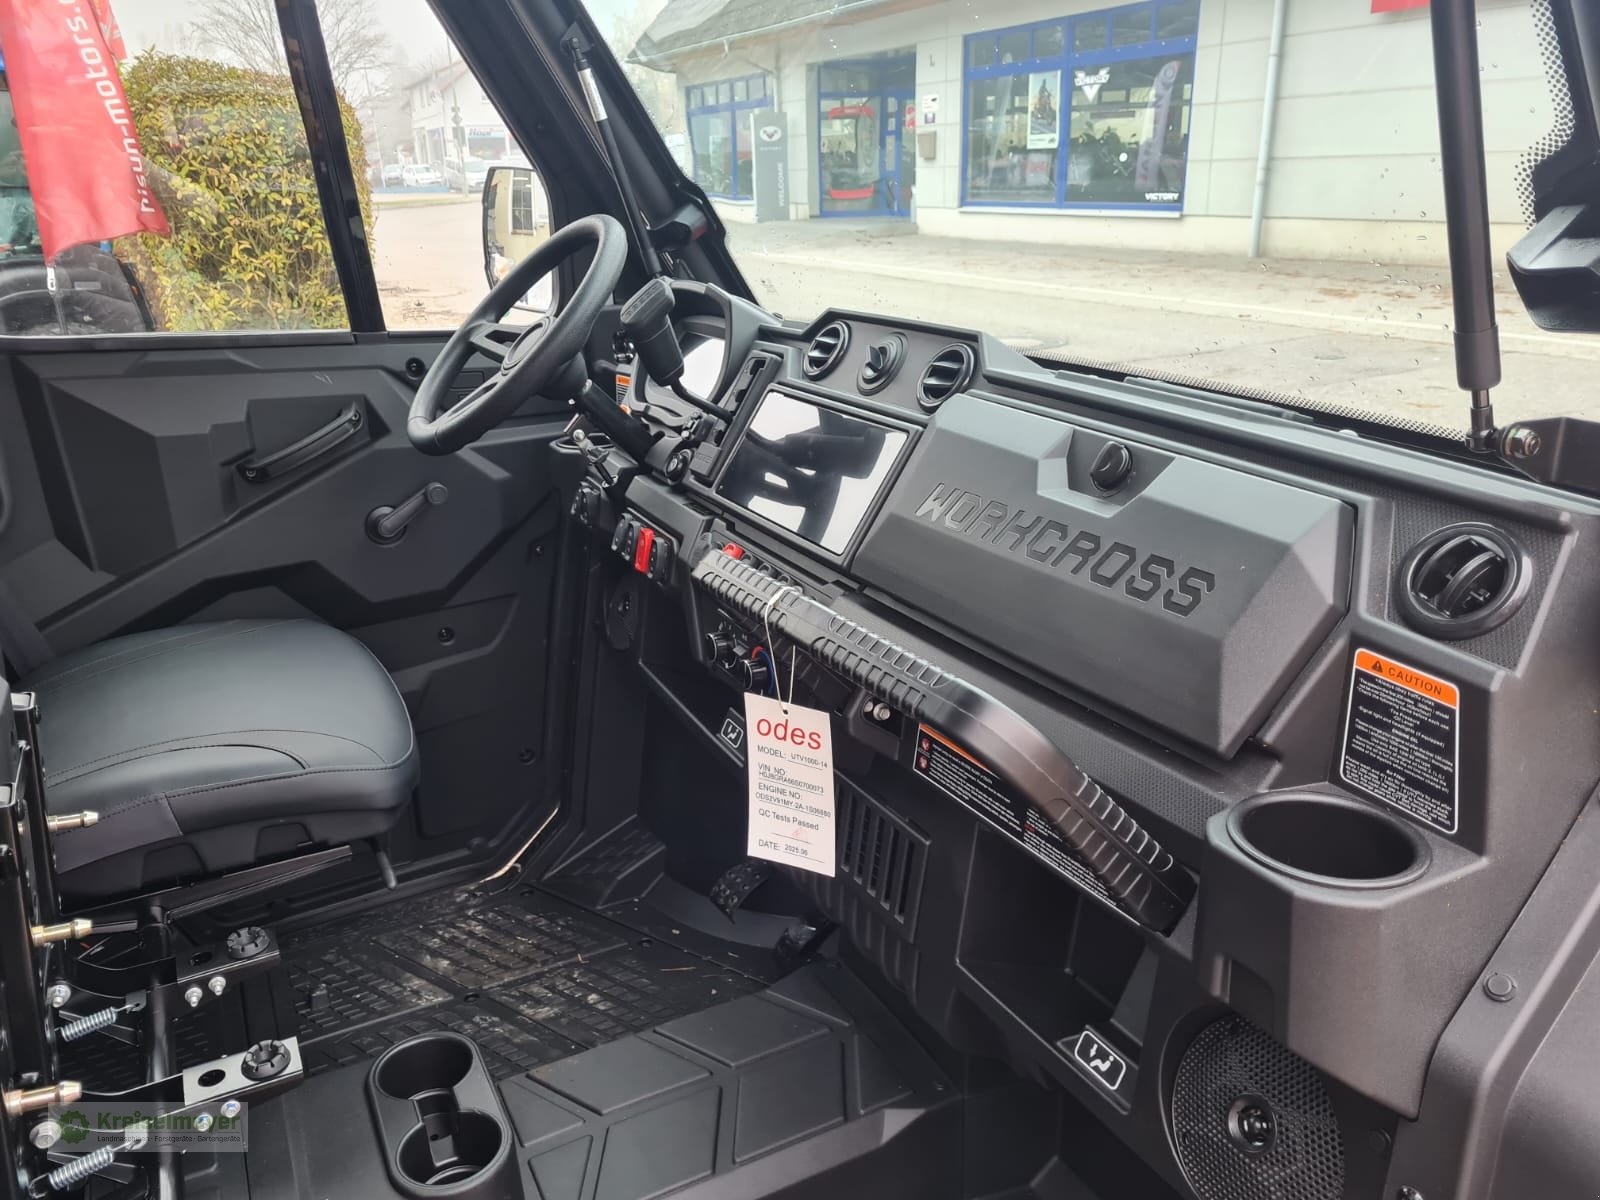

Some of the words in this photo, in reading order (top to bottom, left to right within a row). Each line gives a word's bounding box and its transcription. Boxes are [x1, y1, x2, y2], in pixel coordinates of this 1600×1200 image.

[1145, 192, 1180, 201] VICTORY
[914, 482, 1216, 618] WORKCROSS
[1387, 667, 1443, 696] CAUTION
[756, 718, 822, 750] odes
[757, 744, 786, 759] MODEL:
[758, 762, 770, 772] VIN
[759, 782, 787, 796] ENGINE
[759, 807, 771, 818] QC
[772, 811, 790, 823] Tests
[793, 816, 819, 831] Passed
